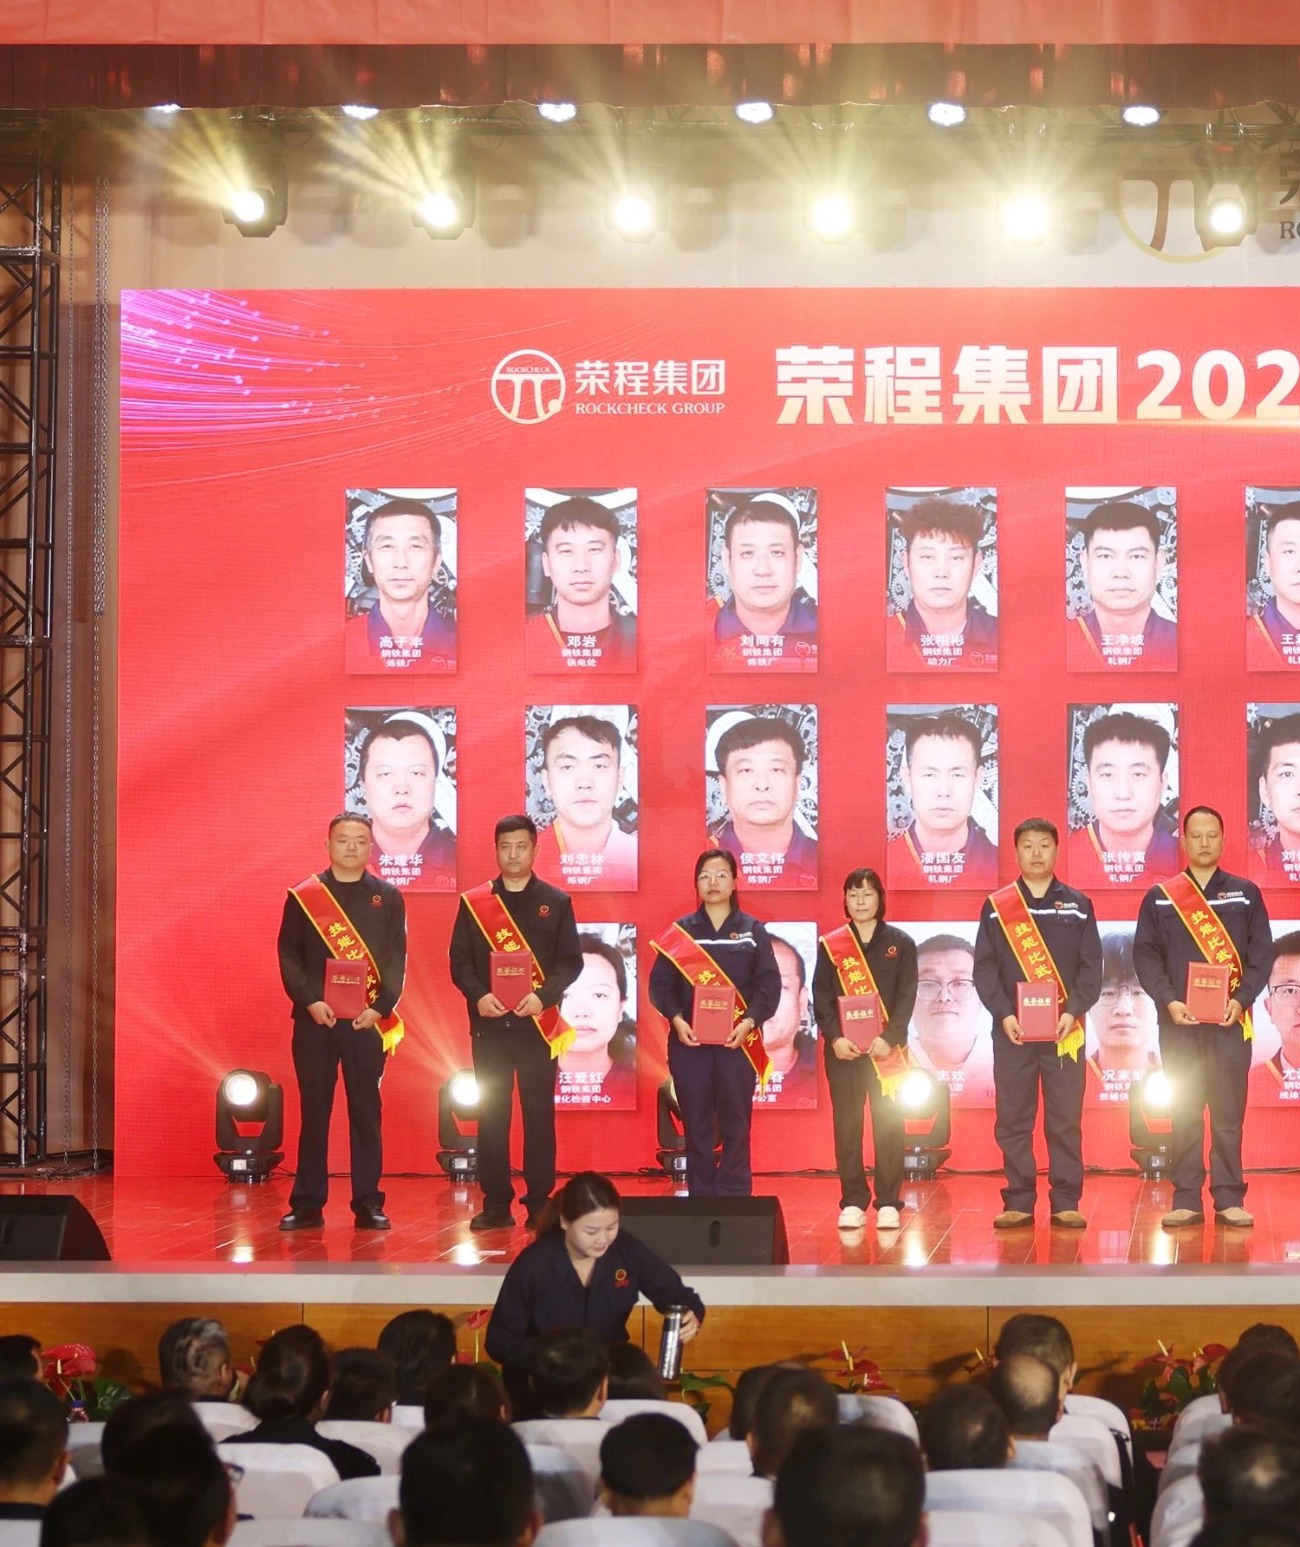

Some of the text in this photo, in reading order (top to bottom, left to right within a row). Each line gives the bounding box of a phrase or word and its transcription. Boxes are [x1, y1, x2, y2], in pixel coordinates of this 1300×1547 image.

[574, 359, 726, 396] 荣程集团
[575, 402, 725, 415] ROCKCHECK GROUP
[567, 635, 598, 648] 邓岩
[381, 649, 422, 658] 钢铁集团
[562, 649, 602, 658] 钢铁集团
[742, 648, 783, 657] 钢铁集团
[922, 648, 963, 656] 钢铁集团
[1102, 647, 1143, 656] 钢铁集团
[381, 868, 422, 876] 钢铁集团
[562, 866, 602, 875] 钢铁集团
[742, 866, 783, 874] 钢铁集团
[923, 865, 964, 874] 钢铁集团
[1104, 864, 1144, 873] 钢铁集团
[561, 1085, 602, 1093] 钢铁集团
